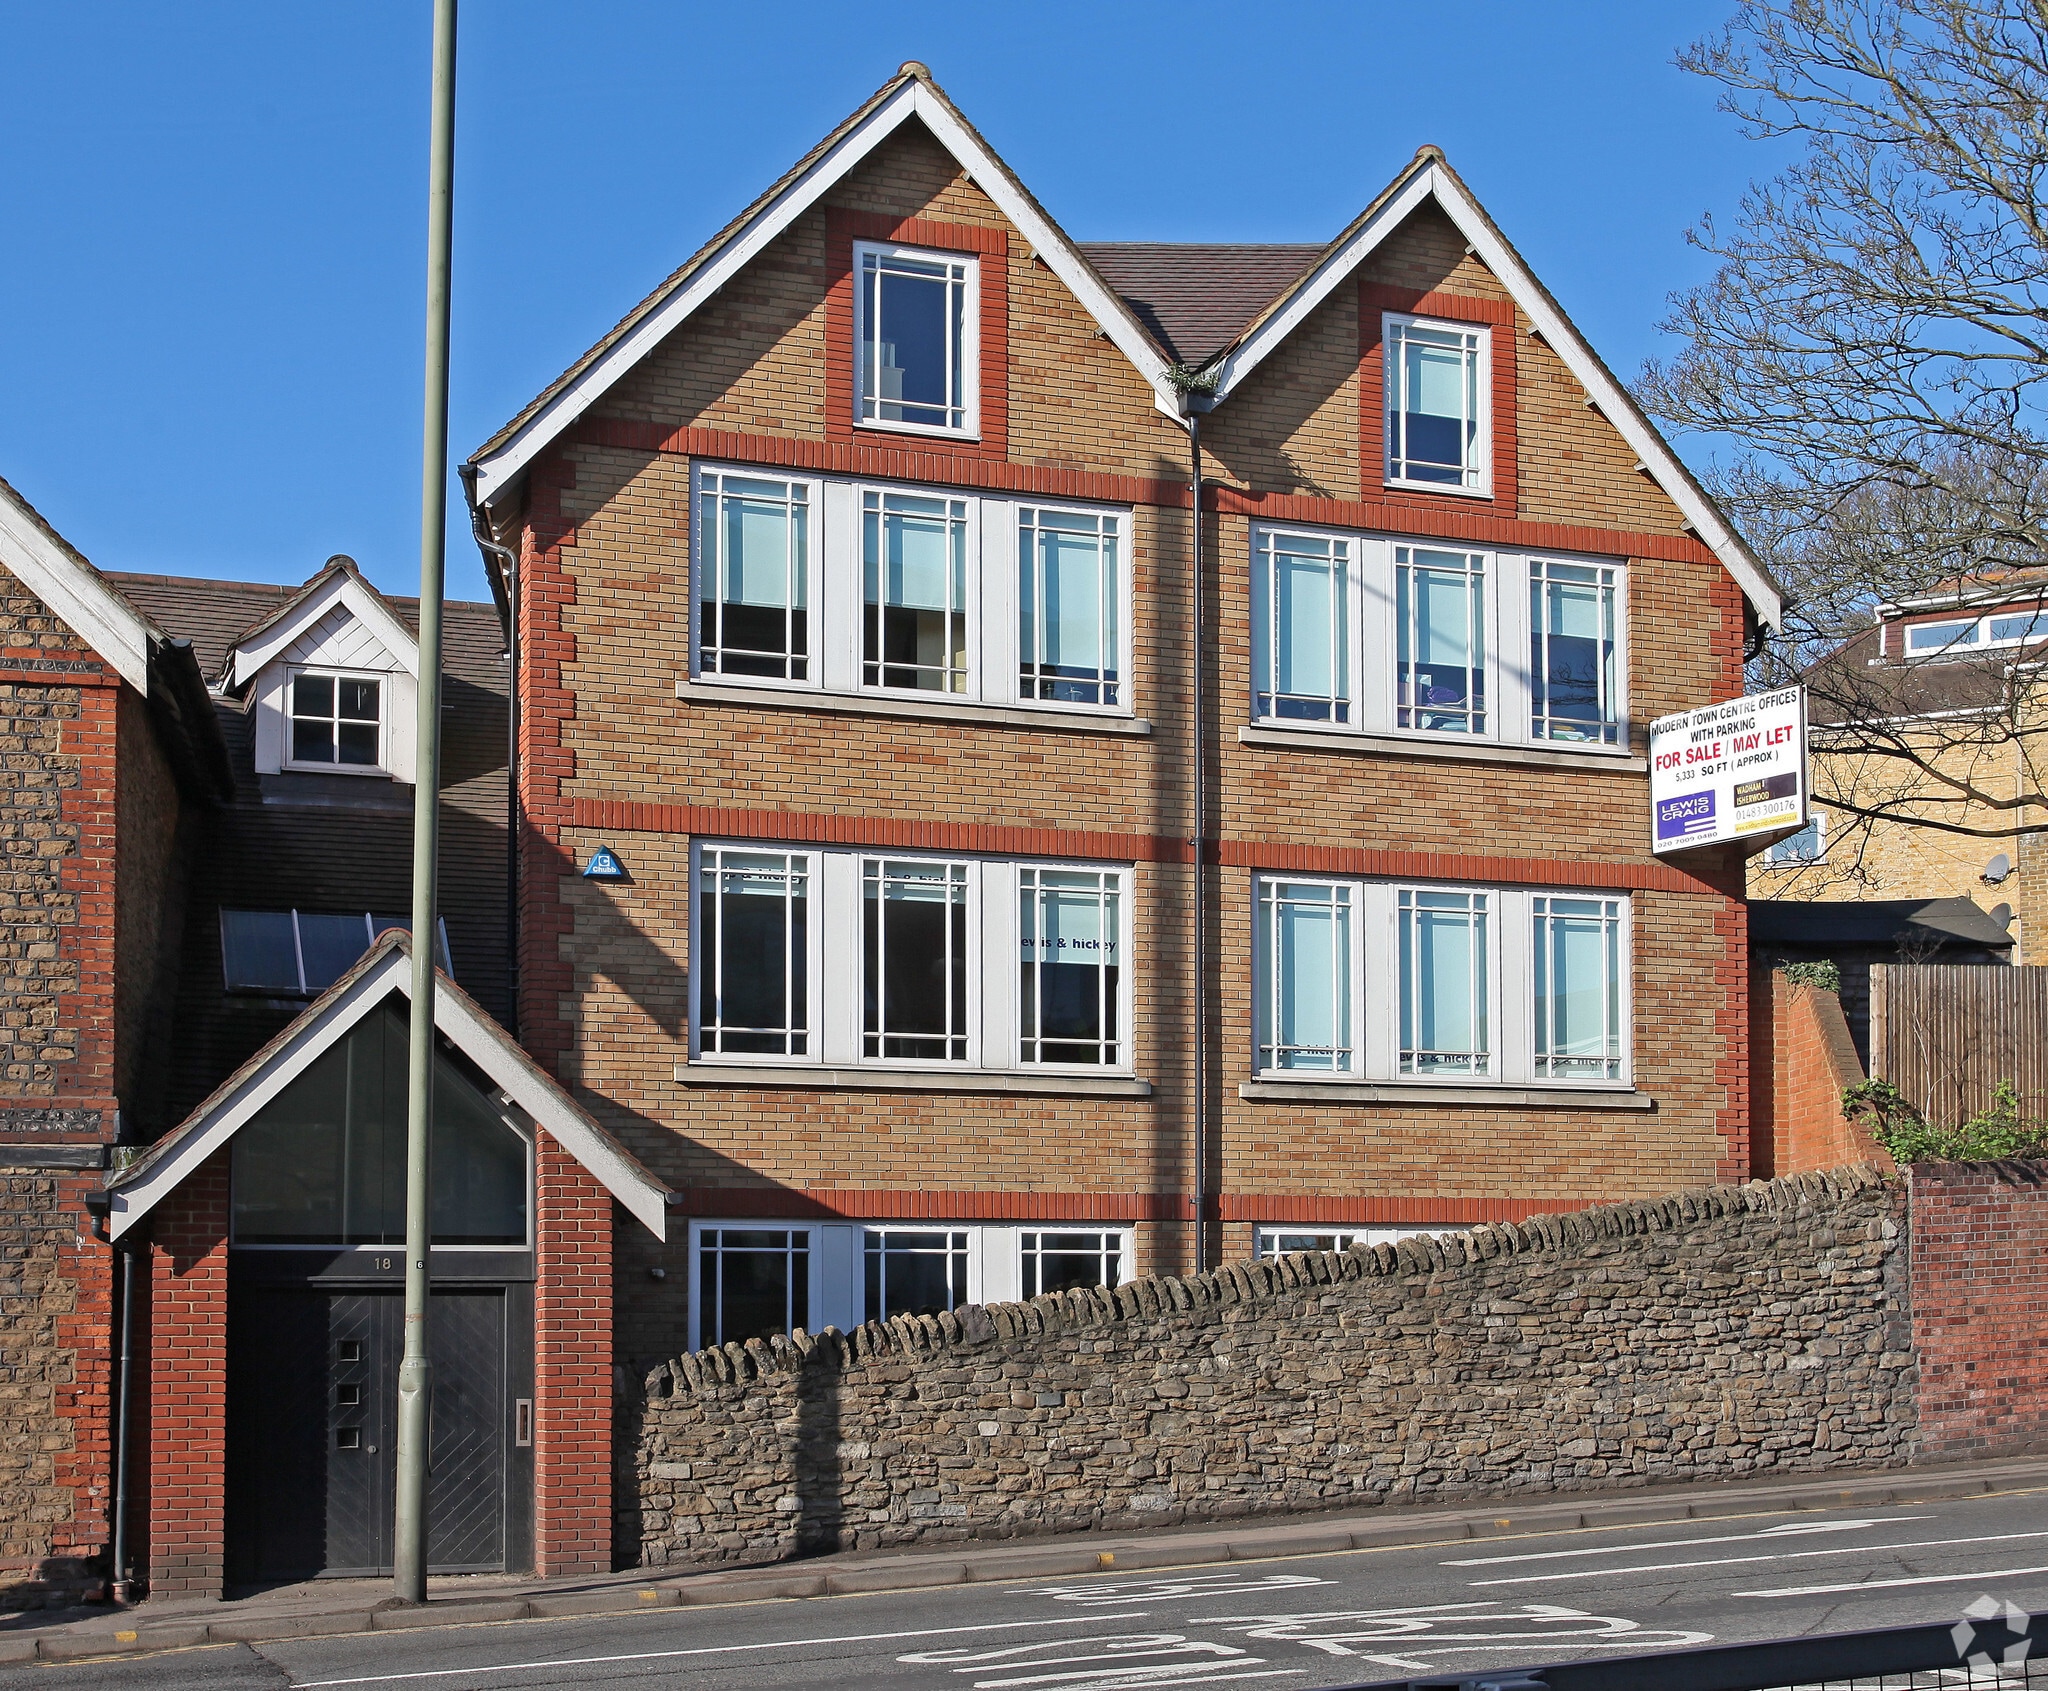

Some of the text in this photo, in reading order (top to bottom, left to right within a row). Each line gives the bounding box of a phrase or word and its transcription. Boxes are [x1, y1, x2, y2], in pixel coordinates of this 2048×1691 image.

[1652, 690, 1797, 736] MODERN TOWN CENTRE OFFICES
[1691, 717, 1756, 743] WITH PARKING
[1656, 751, 1681, 771] FOR
[1686, 742, 1722, 764] SALE
[1733, 732, 1761, 754] MAY
[1766, 725, 1793, 746] LET
[1676, 769, 1695, 782] 5,333
[1701, 765, 1714, 776] SQ
[1716, 762, 1728, 773] FT
[1736, 782, 1762, 795] WADHAM
[1661, 796, 1709, 814] LEWIS
[1736, 791, 1770, 806] ISHERWOOD
[1661, 805, 1709, 822] CRAIG
[1657, 841, 1673, 849] 020
[1675, 836, 1695, 845] 7009
[1020, 937, 1052, 948] ewis
[1056, 937, 1067, 948] &
[375, 1258, 392, 1270] 18
[417, 1261, 423, 1269] 6
